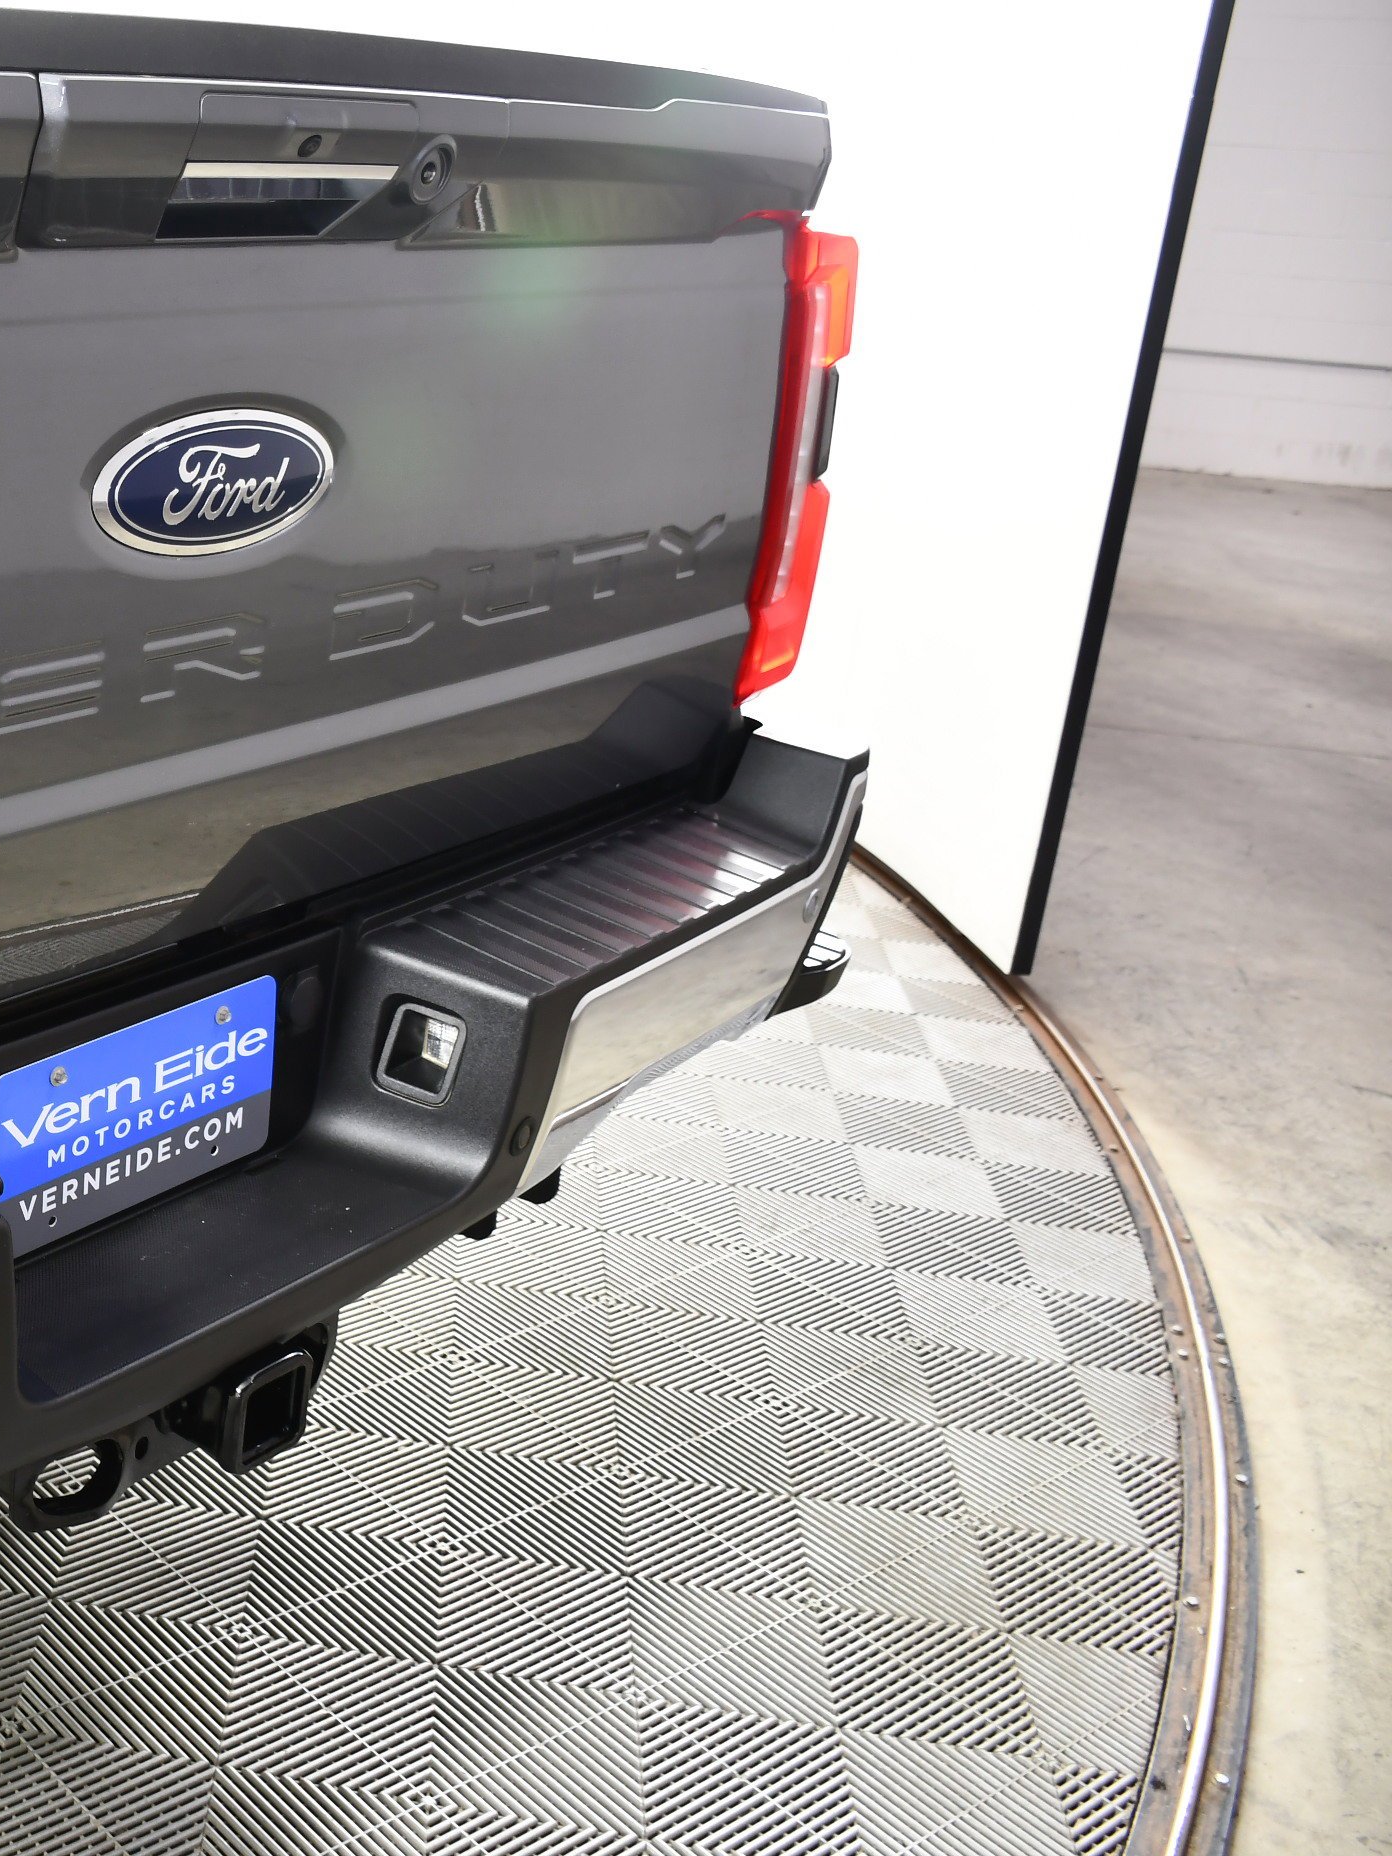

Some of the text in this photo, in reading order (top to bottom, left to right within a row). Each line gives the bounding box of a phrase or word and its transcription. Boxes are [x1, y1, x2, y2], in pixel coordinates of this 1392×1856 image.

[162, 443, 290, 526] Ford
[328, 513, 727, 662] DUTY
[1, 1026, 268, 1148] Vern Eide
[47, 1075, 235, 1168] MOTORCARS
[19, 1106, 244, 1222] VERNEIDE.COM
